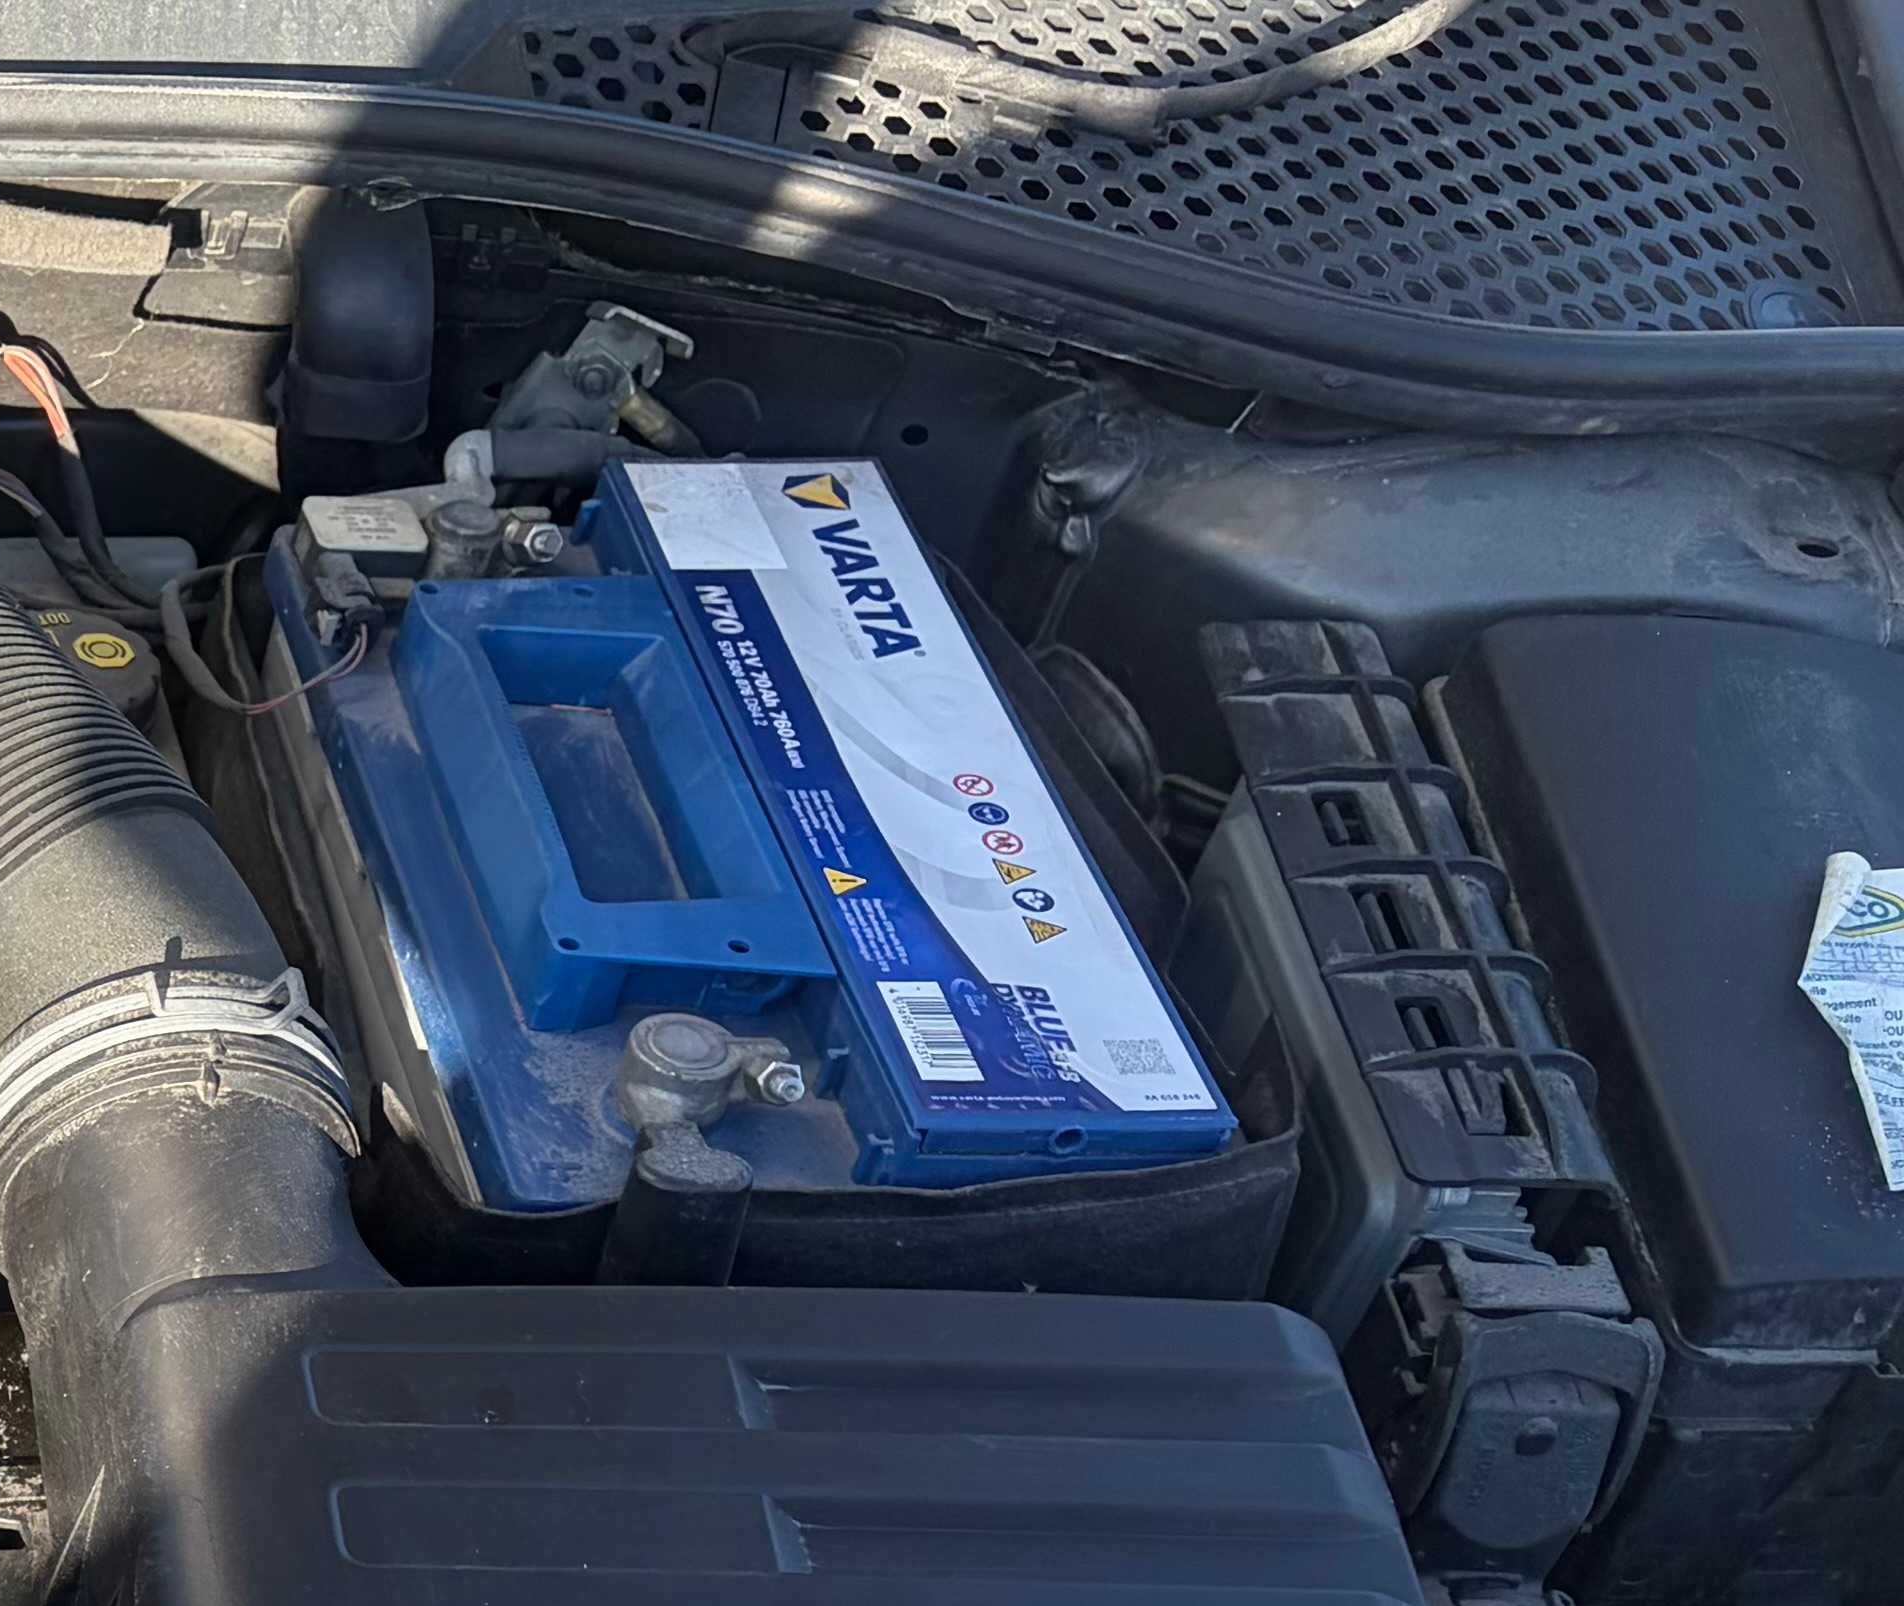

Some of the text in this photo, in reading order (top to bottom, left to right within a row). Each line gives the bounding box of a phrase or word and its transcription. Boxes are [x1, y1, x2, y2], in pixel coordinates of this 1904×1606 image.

[695, 585, 745, 635] N70
[812, 517, 922, 660] VARTA
[737, 640, 764, 668] 12V
[751, 671, 781, 707] 70Ah
[768, 710, 801, 749] 760A
[993, 983, 1056, 1082] DYNAMIC
[1014, 985, 1078, 1053] BLUE
